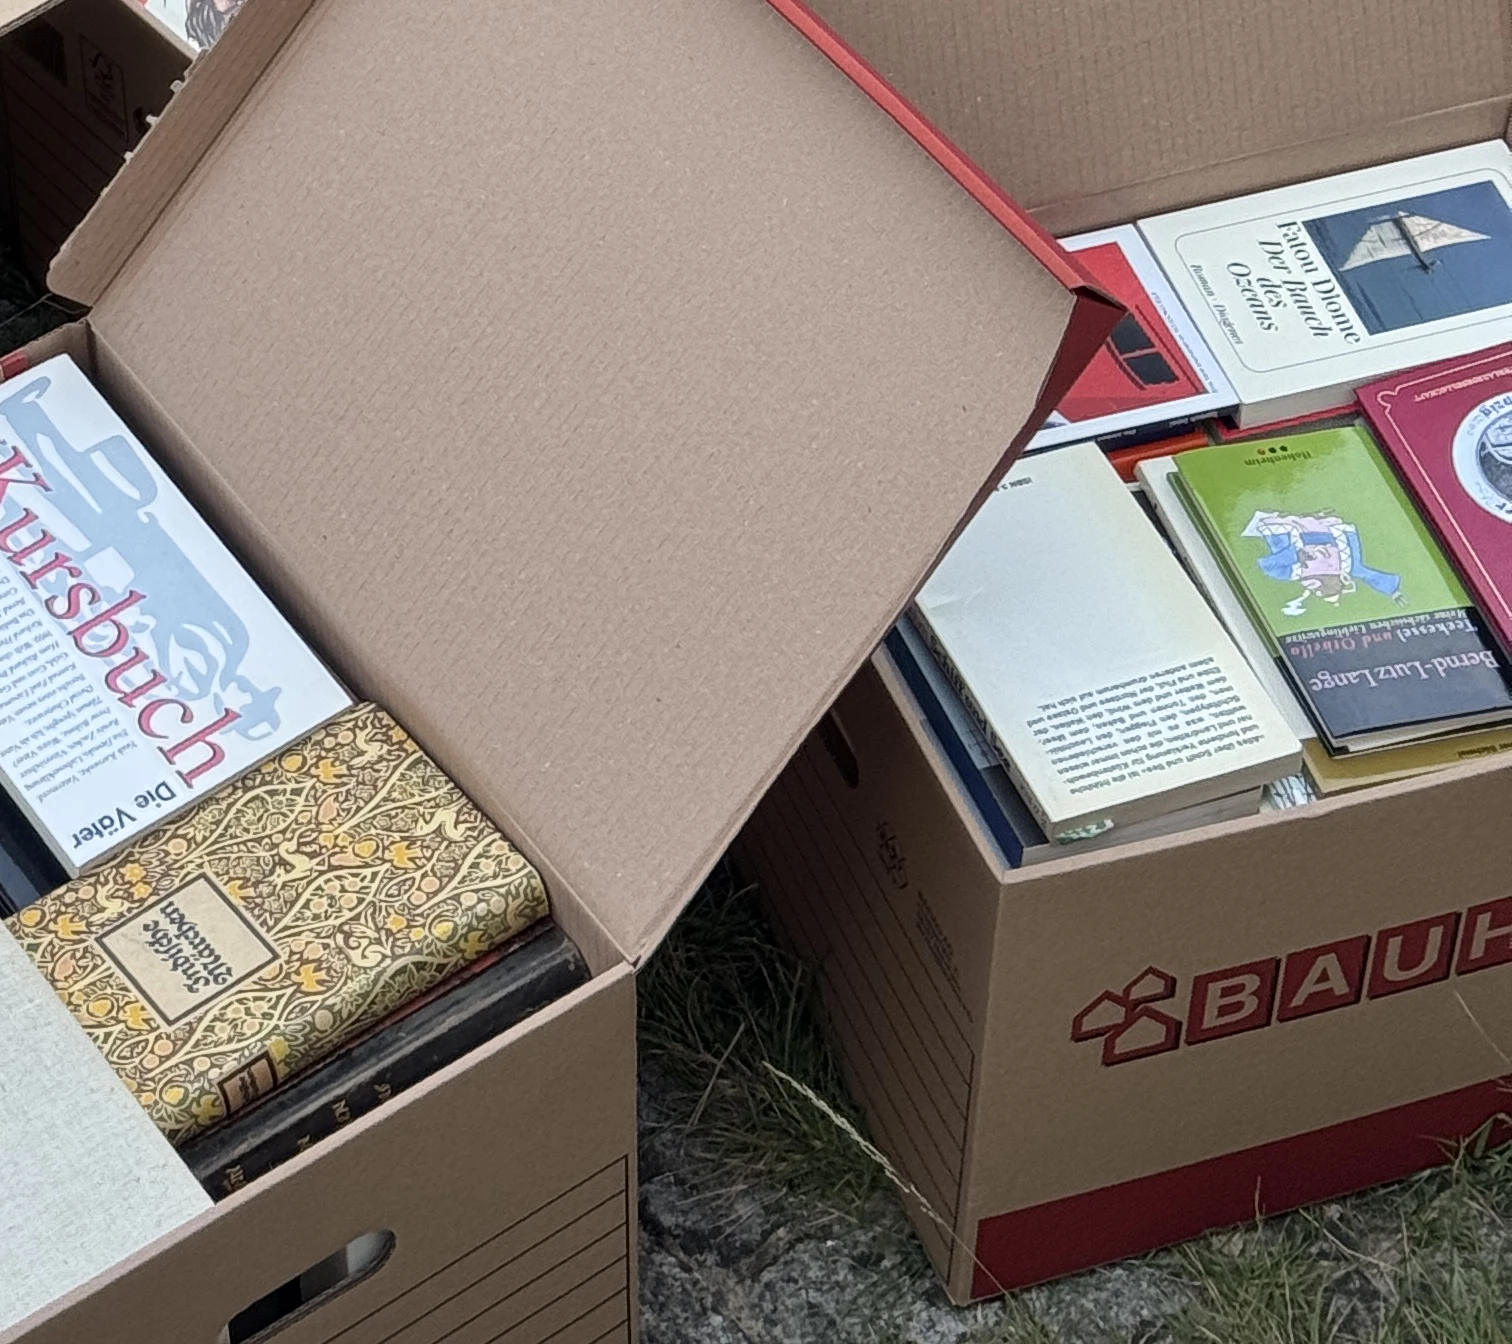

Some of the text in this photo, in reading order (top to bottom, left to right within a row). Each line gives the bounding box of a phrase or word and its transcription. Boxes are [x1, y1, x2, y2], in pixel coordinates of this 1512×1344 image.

[1224, 259, 1285, 333] Ozeans
[1254, 274, 1292, 310] des
[1255, 234, 1335, 338] Der Bauch
[1275, 219, 1369, 345] Fatou Diome
[1302, 648, 1501, 692] Bernd-Lutz Lange
[1358, 630, 1395, 646] und
[65, 779, 178, 854] Die Väter
